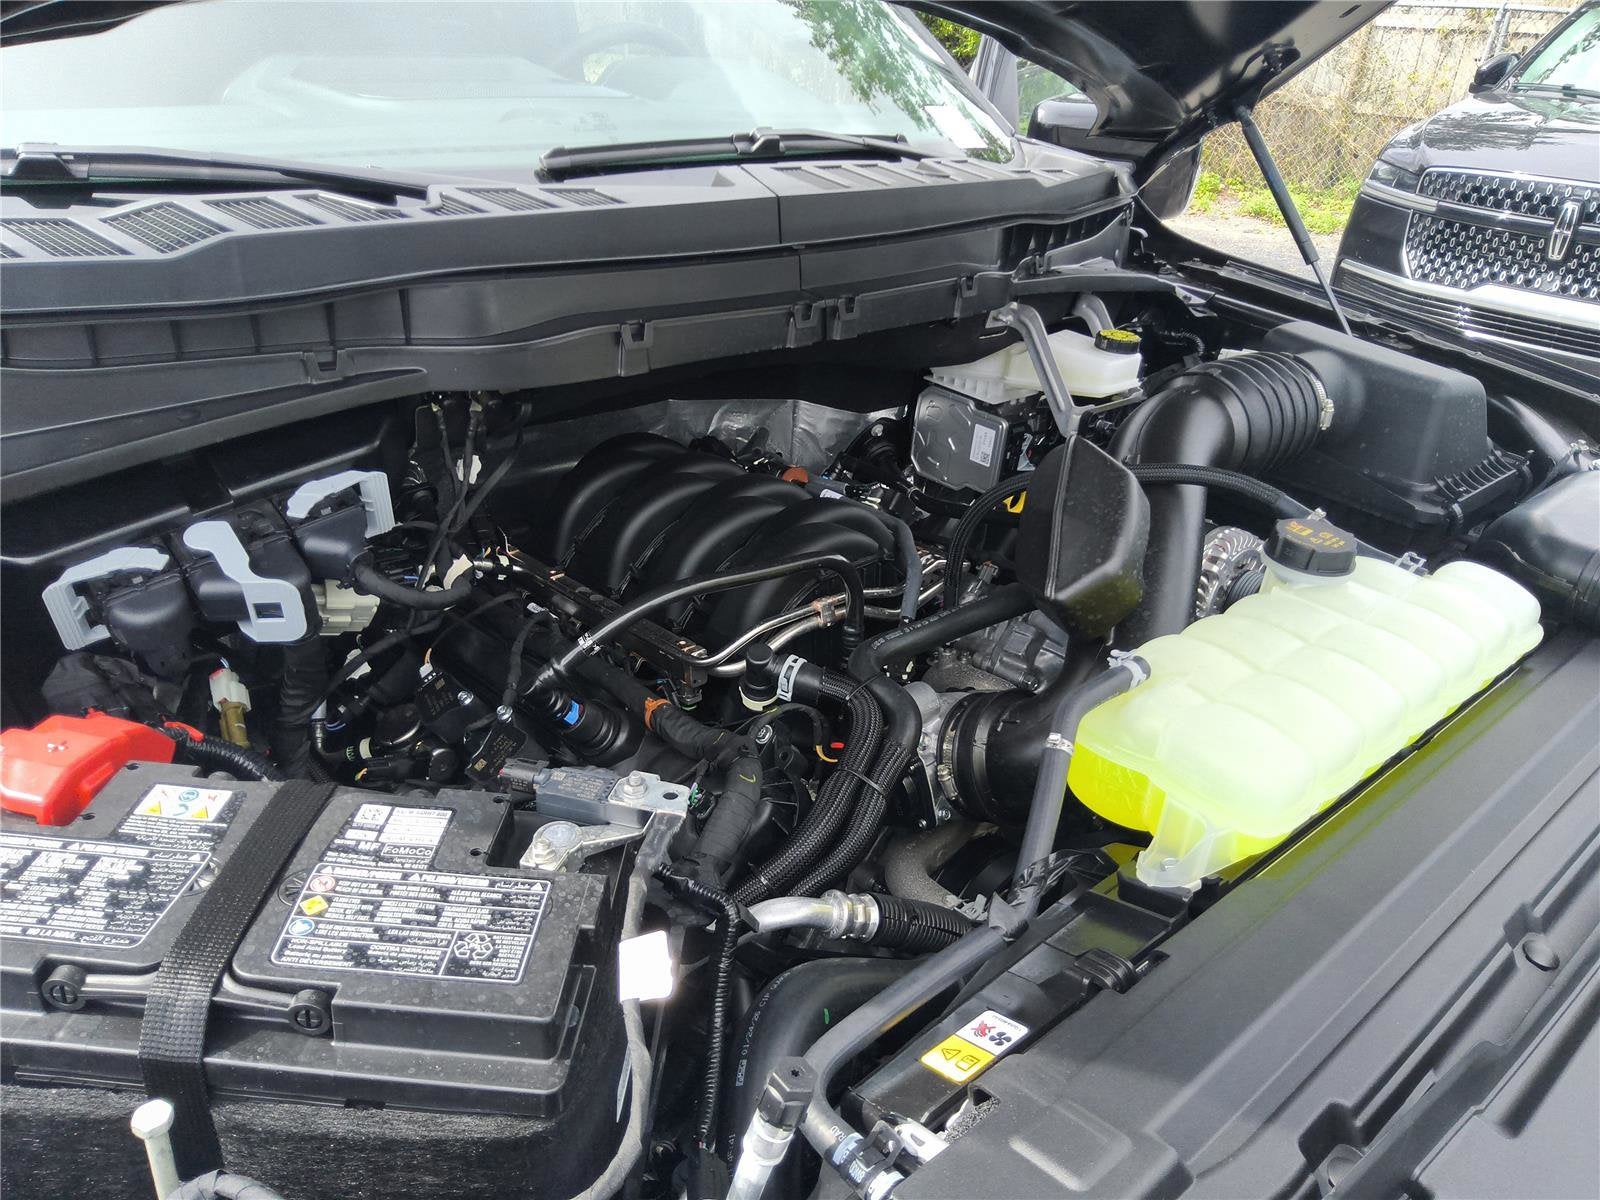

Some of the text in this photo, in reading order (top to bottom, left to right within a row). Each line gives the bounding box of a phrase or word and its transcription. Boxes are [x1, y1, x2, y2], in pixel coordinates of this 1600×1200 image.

[358, 841, 380, 851] MF
[383, 846, 432, 857] FoMoCo
[290, 938, 348, 947] NON-SPILLABLE
[831, 1125, 847, 1142] RAD
